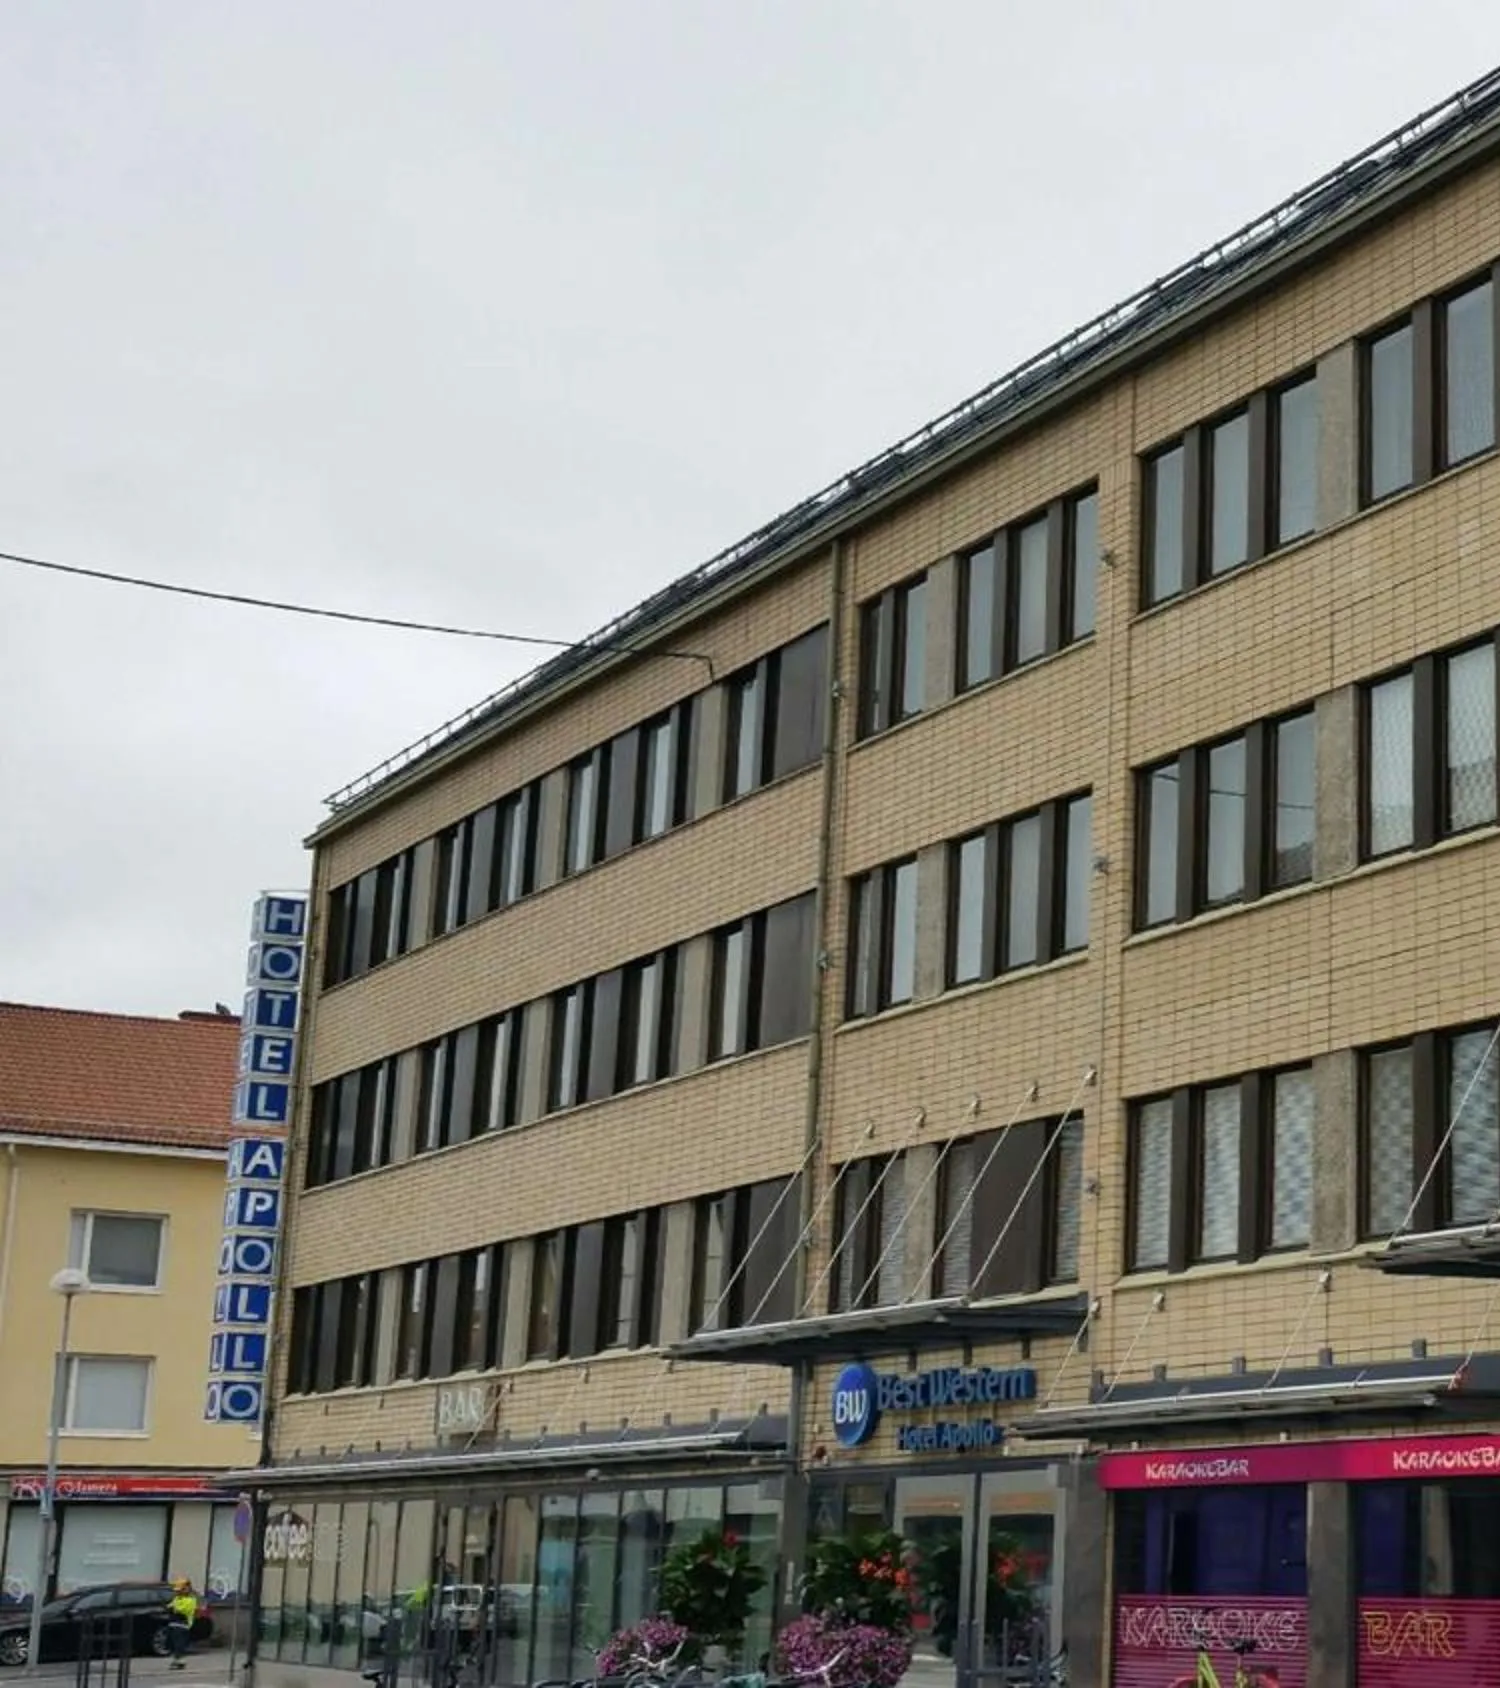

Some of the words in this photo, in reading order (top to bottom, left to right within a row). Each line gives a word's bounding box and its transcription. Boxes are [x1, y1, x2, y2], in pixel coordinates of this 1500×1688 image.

[256, 900, 304, 1118] HOTEL
[222, 1144, 277, 1418] APOLLO
[440, 1387, 486, 1428] BAR
[834, 1388, 868, 1424] BW
[876, 1373, 926, 1410] Best
[929, 1366, 1035, 1405] Western
[896, 1425, 938, 1452] Hotel
[941, 1418, 1002, 1451] Apollo
[1119, 1605, 1300, 1652] KARAOKE
[1363, 1610, 1456, 1659] BAR
